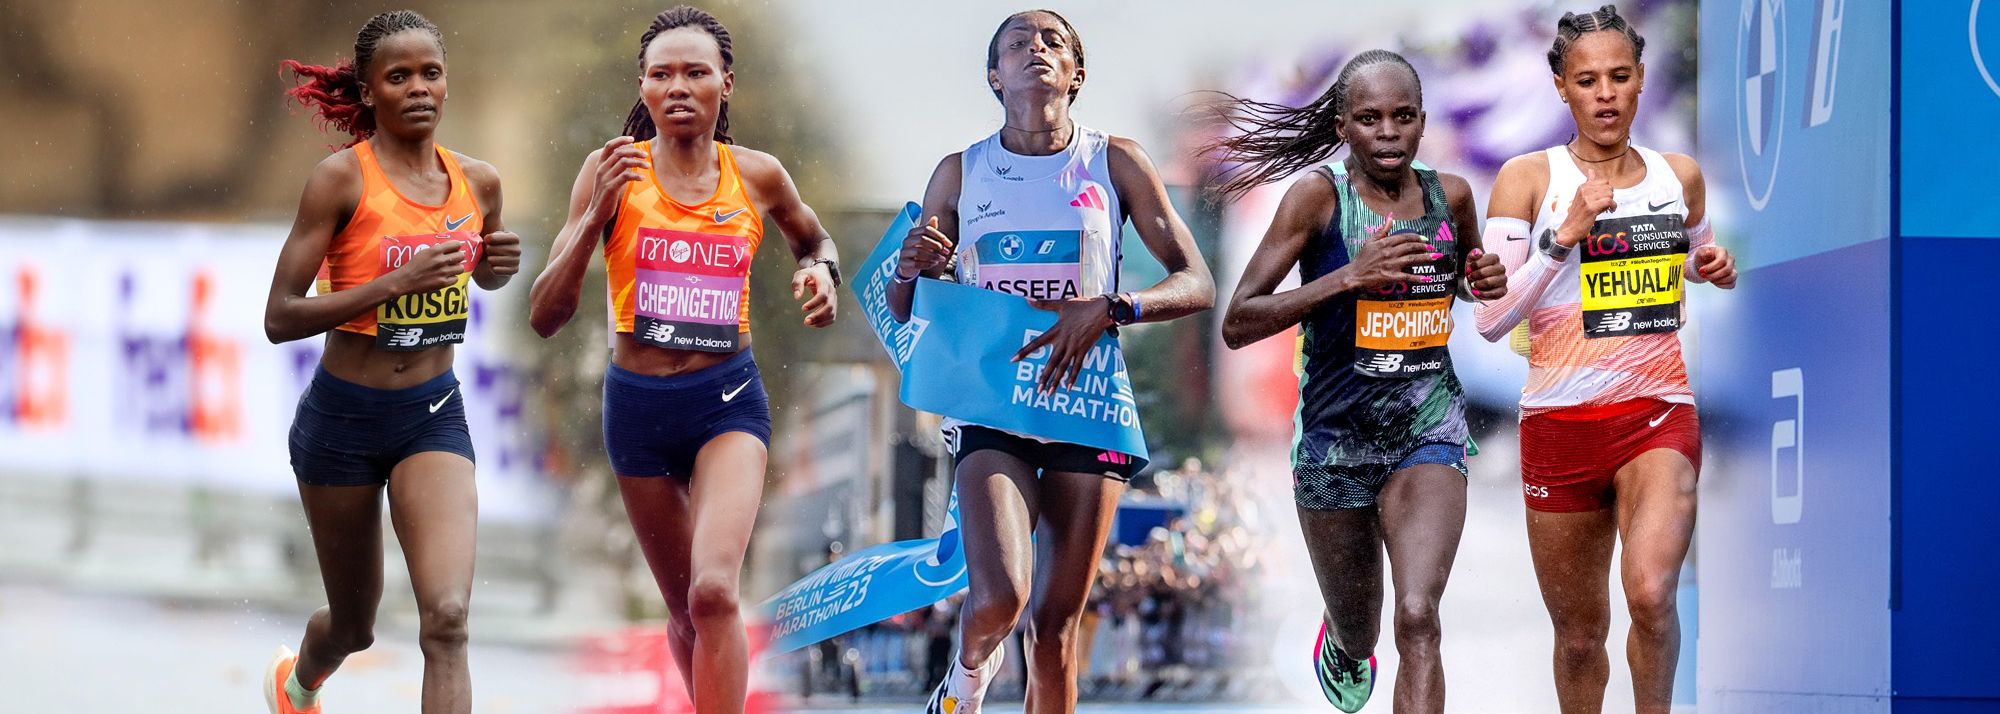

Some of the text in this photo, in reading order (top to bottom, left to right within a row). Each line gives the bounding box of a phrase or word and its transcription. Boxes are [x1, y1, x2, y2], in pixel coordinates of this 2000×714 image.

[1630, 223, 1656, 232] TATA
[1633, 240, 1671, 252] SERVICES
[1411, 265, 1436, 274] TATA
[1411, 283, 1446, 293] SERVICES
[638, 281, 740, 320] CHEPNGETICH
[1633, 321, 1652, 330] new
[422, 336, 440, 345] new
[674, 336, 692, 345] new
[695, 335, 732, 348] balance
[1403, 364, 1421, 373] new
[840, 573, 872, 613] 23
[775, 588, 825, 621] BERLIN
[770, 598, 843, 643] MARATHON
